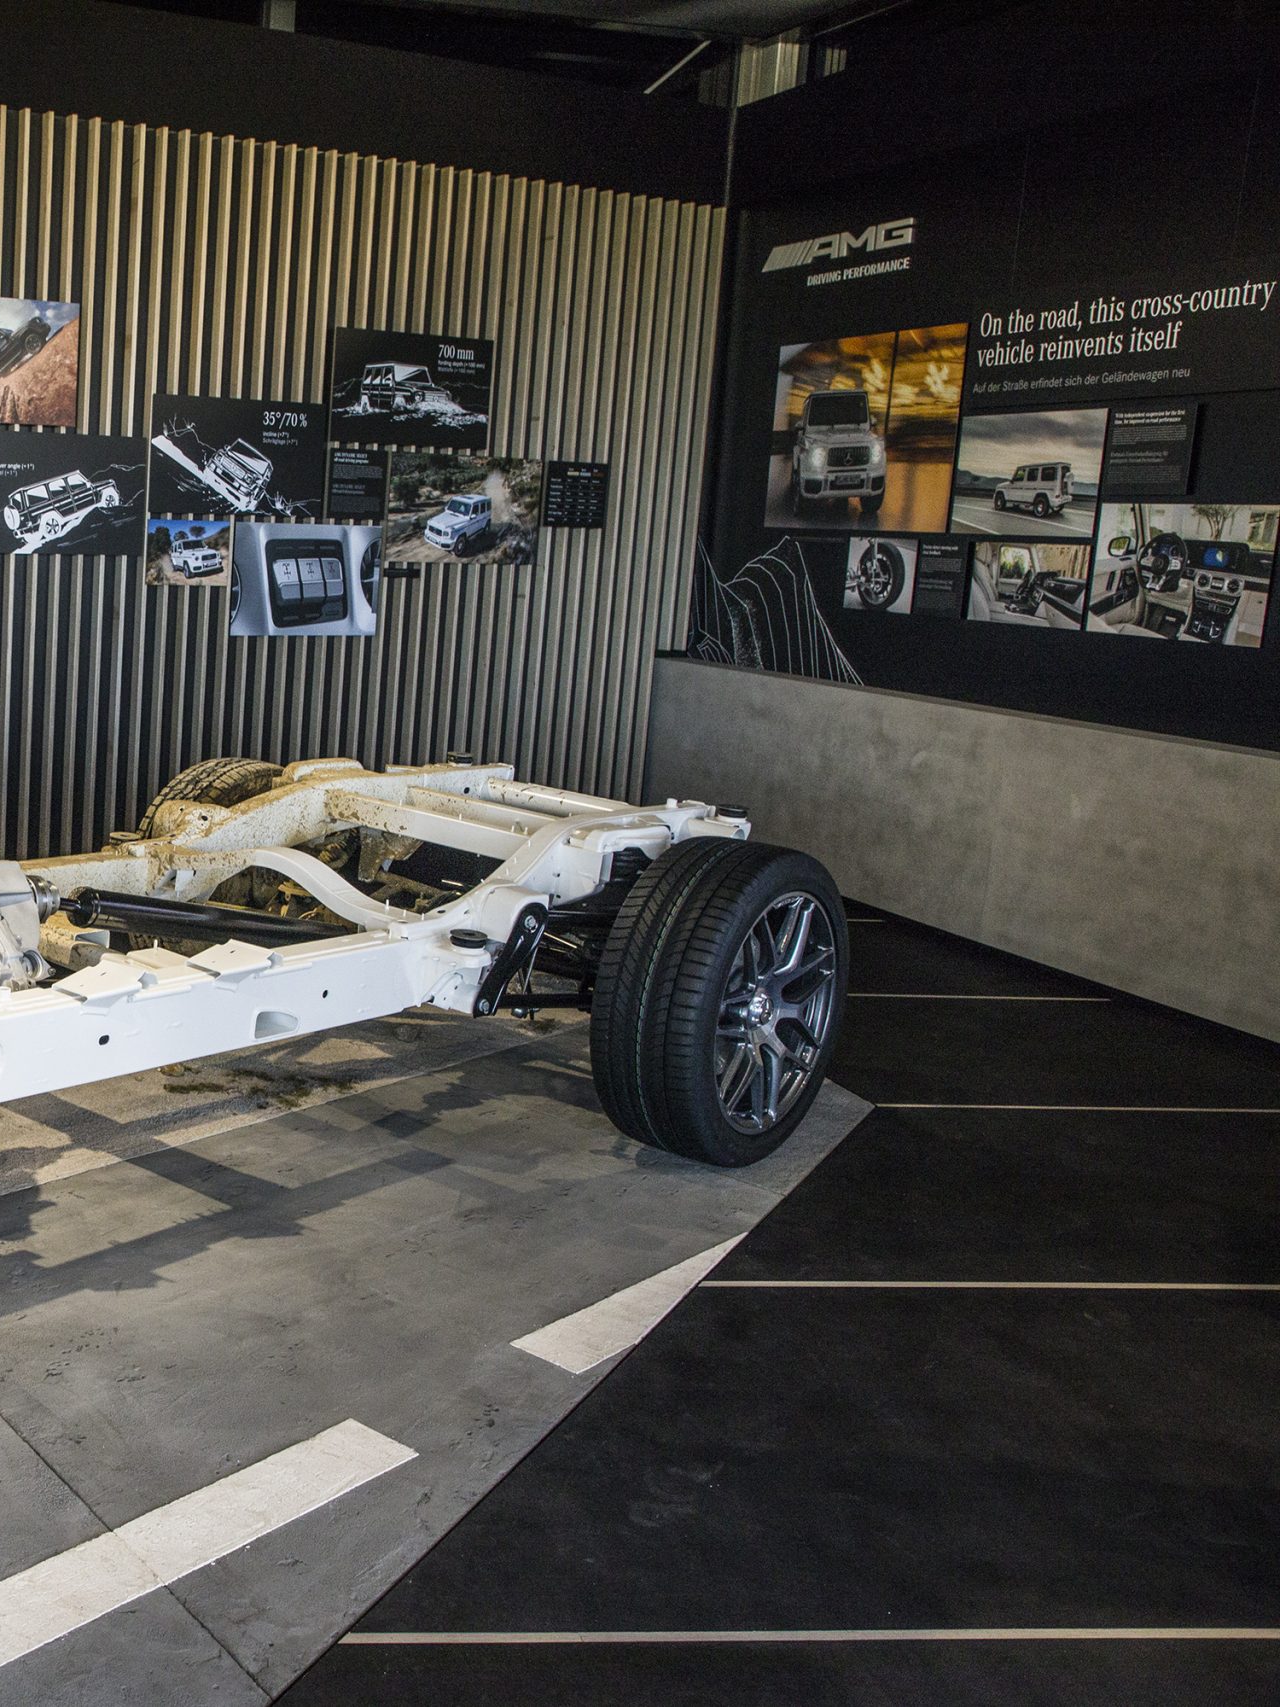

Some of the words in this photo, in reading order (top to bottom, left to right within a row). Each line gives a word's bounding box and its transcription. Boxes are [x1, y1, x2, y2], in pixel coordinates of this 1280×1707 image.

[803, 217, 916, 263] AMG
[807, 270, 842, 287] DRIVING
[843, 257, 911, 280] PERFORMANCE
[980, 312, 1002, 338] On
[1007, 308, 1035, 335] the
[1039, 300, 1083, 332] road,
[1089, 296, 1126, 325] this
[1131, 279, 1278, 320] cross-country
[438, 344, 456, 359] 700
[456, 349, 475, 361] mm
[977, 338, 1035, 368] vehicle
[1039, 331, 1124, 362] reinvents
[1128, 320, 1183, 353] itself
[972, 382, 987, 394] Auf
[987, 381, 1001, 393] der
[1002, 379, 1029, 392] Straße
[1030, 376, 1063, 390] erfindet
[1064, 374, 1082, 387] sich
[1084, 373, 1100, 385] der
[1101, 369, 1170, 385] Geländewagen
[1171, 367, 1191, 378] neu
[262, 411, 298, 430] 35°/70
[299, 413, 308, 428] %
[7, 463, 21, 471] angle
